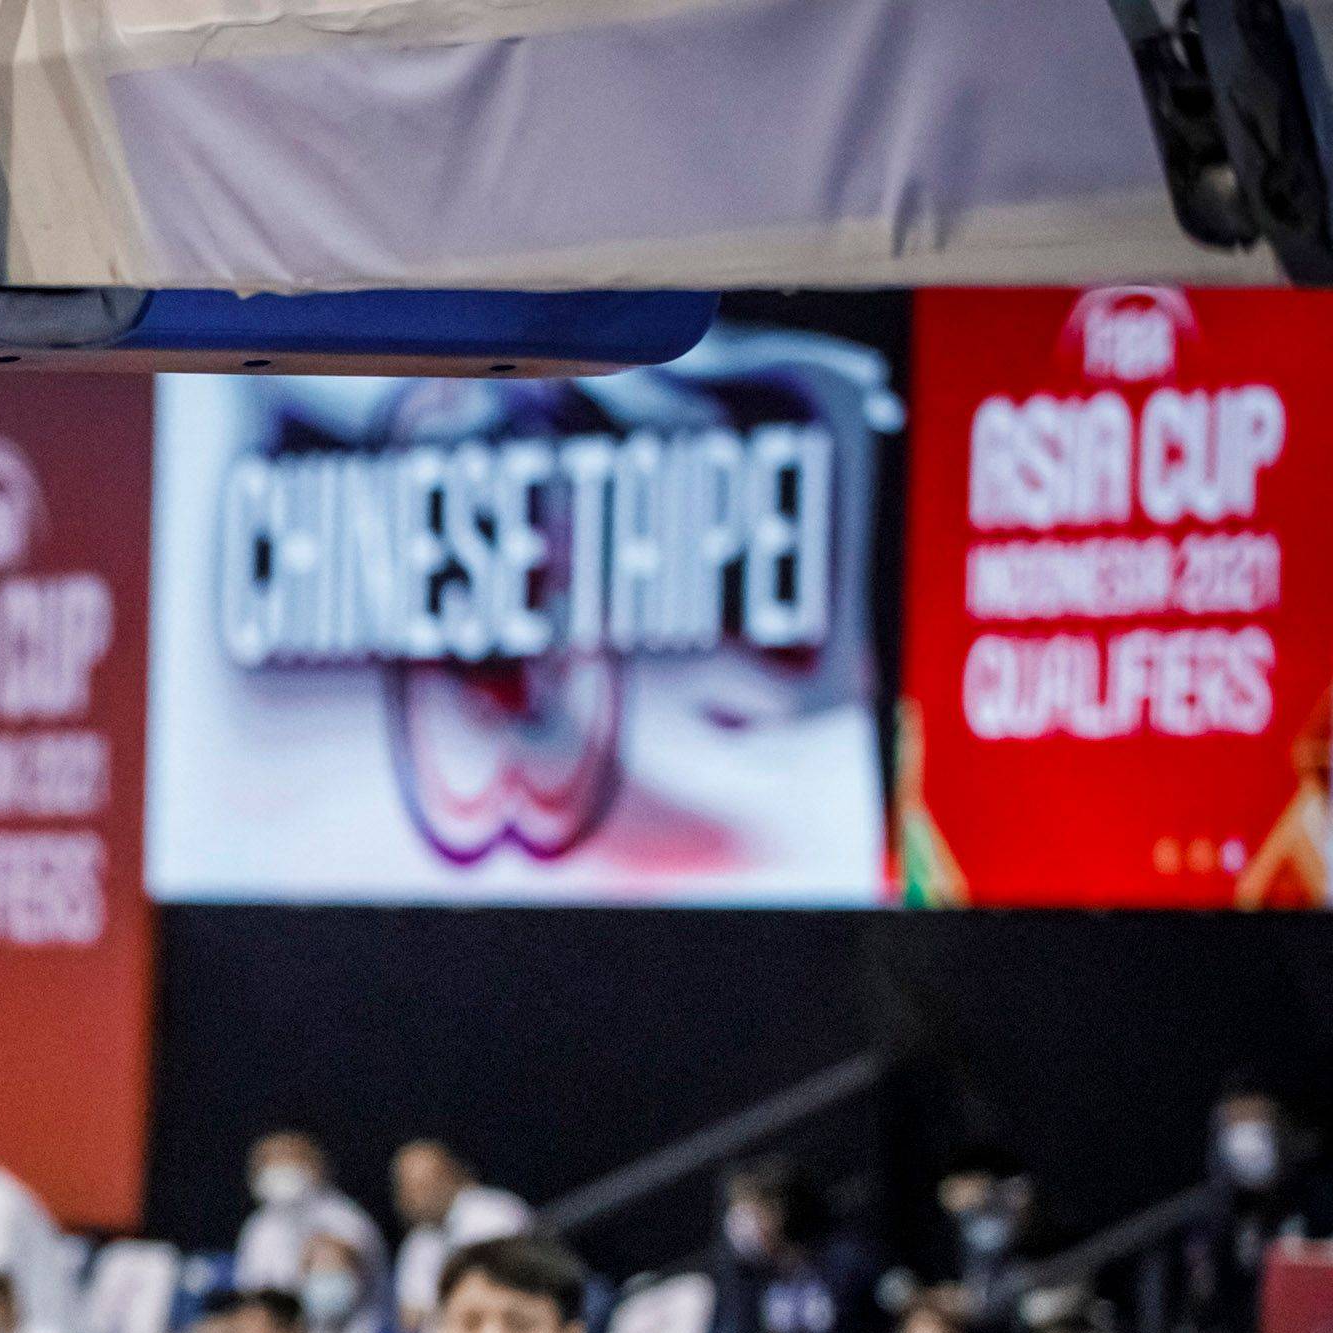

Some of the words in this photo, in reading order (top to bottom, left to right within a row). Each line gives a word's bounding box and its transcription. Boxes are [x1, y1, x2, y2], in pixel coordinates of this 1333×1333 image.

[970, 391, 1132, 530] ASIA
[1139, 384, 1286, 525] CUP
[223, 440, 555, 665] CHINESE
